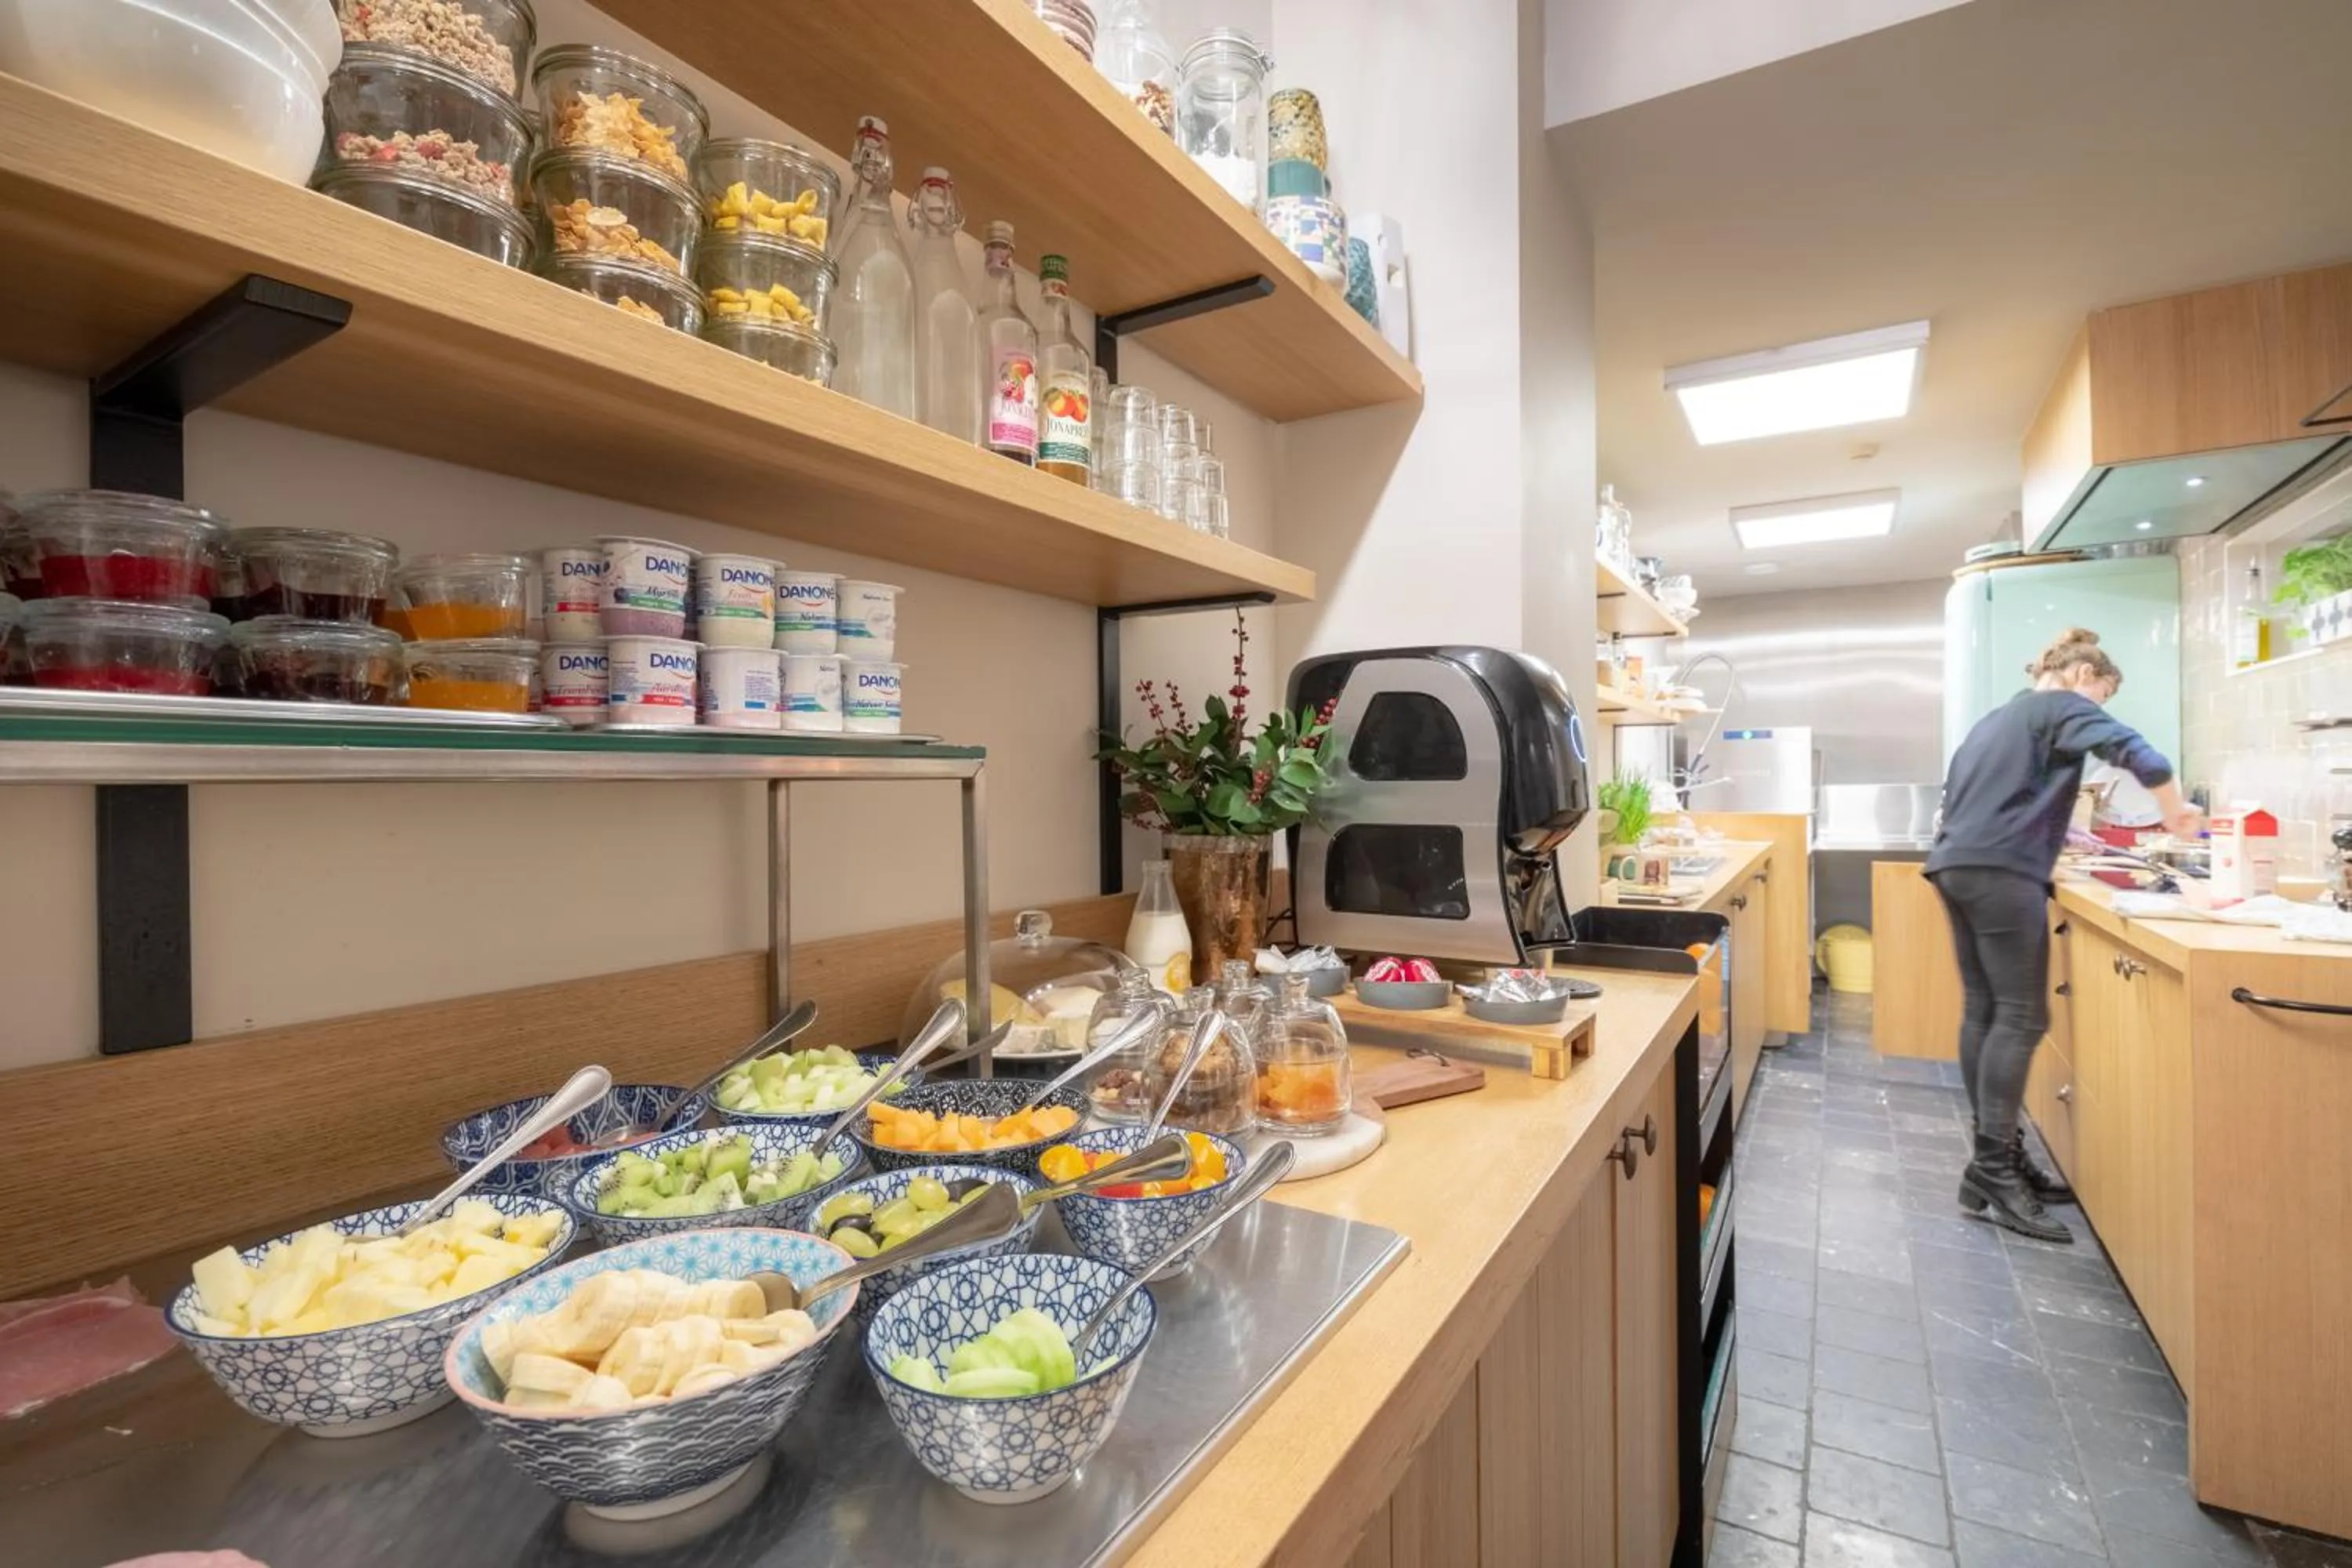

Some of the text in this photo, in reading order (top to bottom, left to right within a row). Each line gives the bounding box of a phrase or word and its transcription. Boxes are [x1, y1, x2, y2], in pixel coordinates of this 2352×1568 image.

[562, 561, 601, 577] DAN
[645, 556, 688, 577] DANO
[720, 568, 775, 586] DANON
[559, 655, 608, 670] DANO
